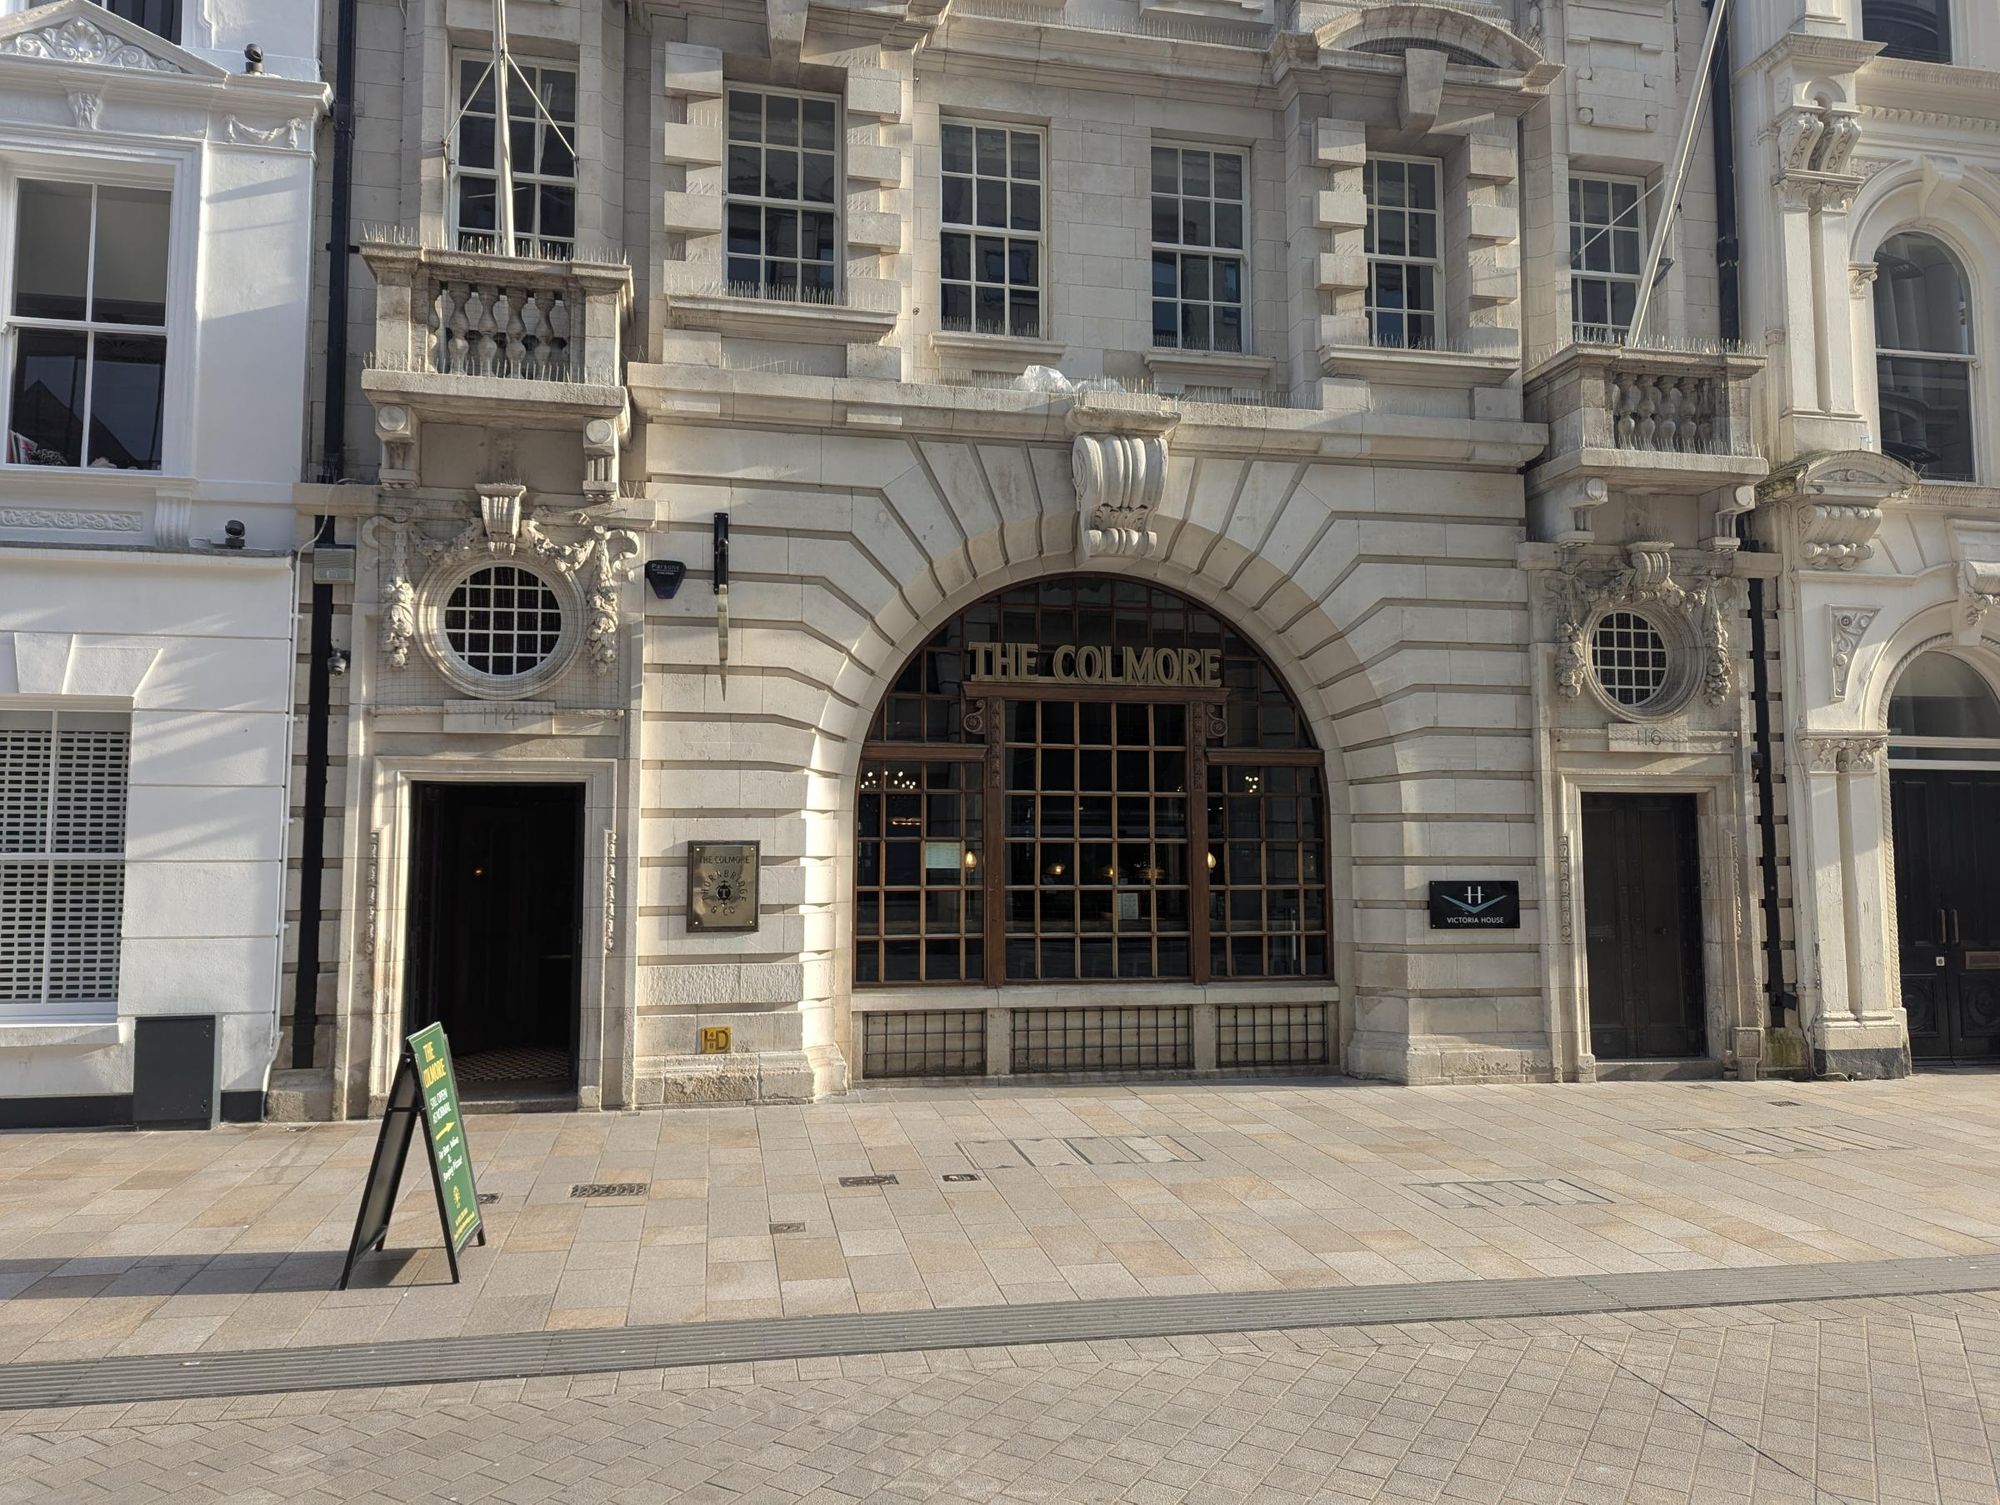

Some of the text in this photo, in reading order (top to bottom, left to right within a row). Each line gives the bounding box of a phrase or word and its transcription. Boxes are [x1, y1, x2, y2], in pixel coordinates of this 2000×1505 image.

[968, 641, 1222, 687] THE COLMORE
[483, 707, 519, 726] 114
[1636, 729, 1661, 746] 116
[700, 855, 750, 864] THE COLMORE
[1446, 916, 1504, 924] VICTORIA HOUSE
[423, 1042, 435, 1062] THE
[437, 1088, 448, 1103] OPEN
